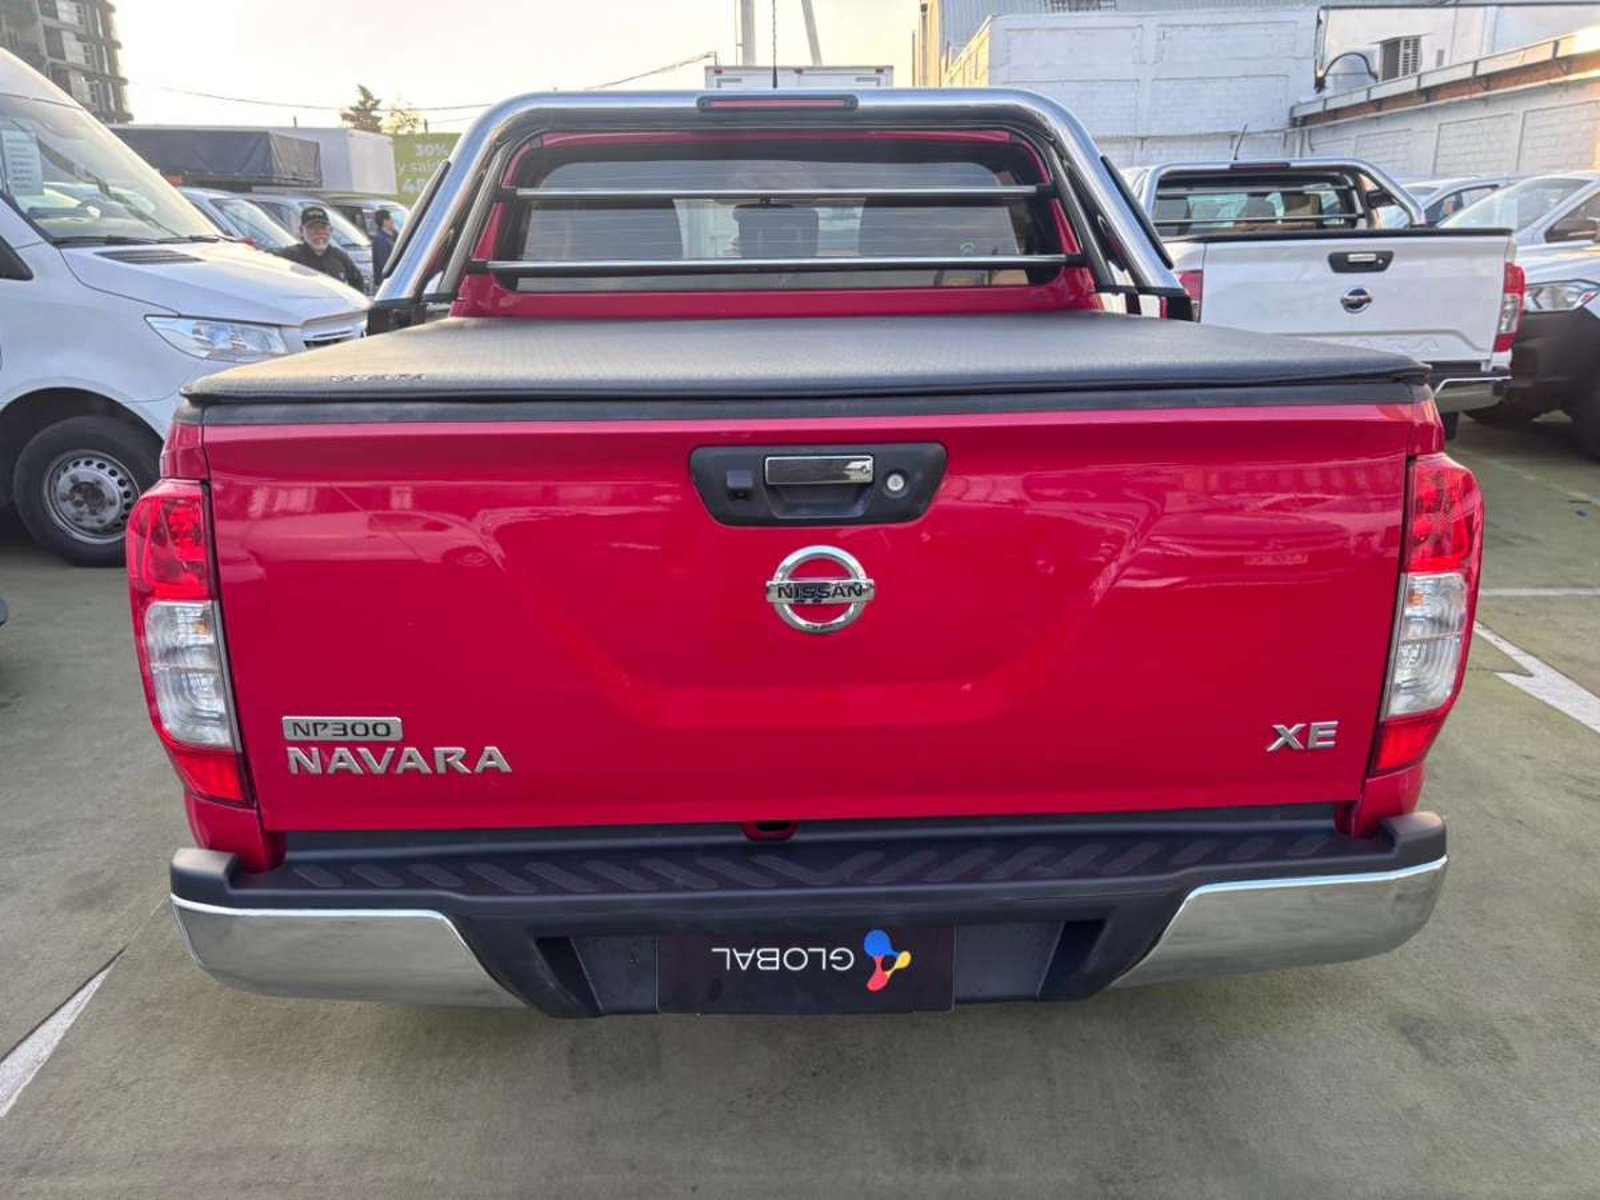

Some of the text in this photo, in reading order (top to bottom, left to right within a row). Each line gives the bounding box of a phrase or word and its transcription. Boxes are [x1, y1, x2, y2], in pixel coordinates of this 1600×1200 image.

[777, 583, 864, 599] NISSAN
[291, 721, 393, 738] NP300
[1266, 720, 1339, 752] XE
[286, 746, 513, 775] NAVARA
[711, 947, 855, 971] GLOBAL
